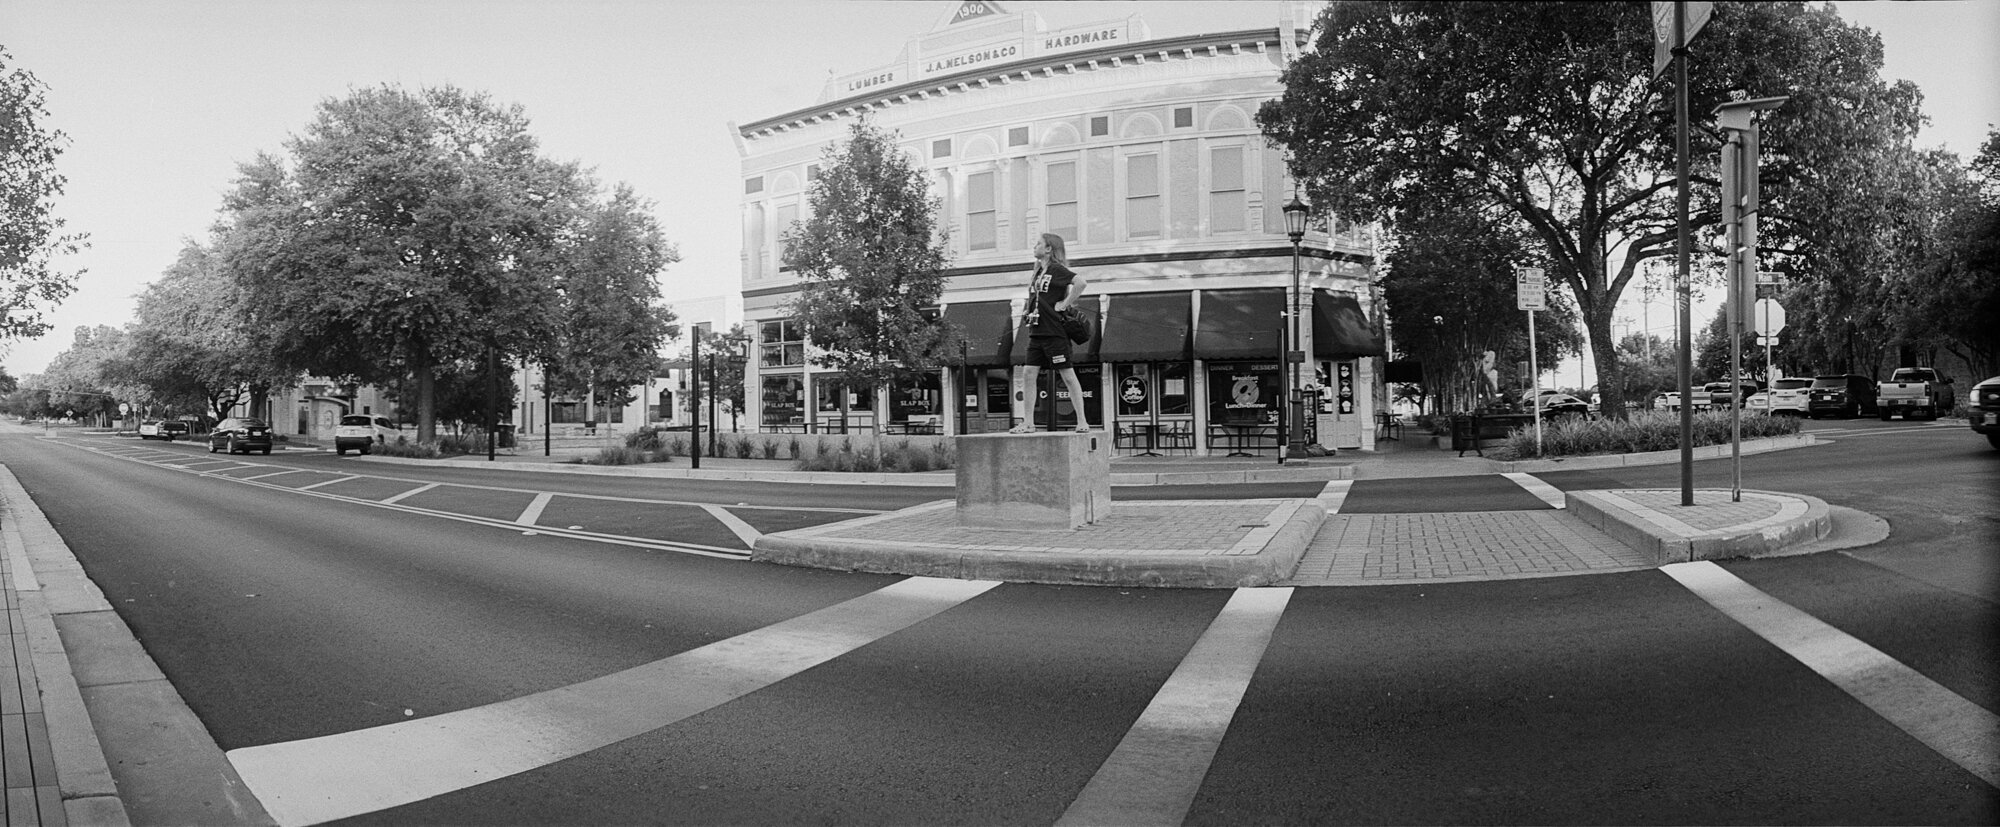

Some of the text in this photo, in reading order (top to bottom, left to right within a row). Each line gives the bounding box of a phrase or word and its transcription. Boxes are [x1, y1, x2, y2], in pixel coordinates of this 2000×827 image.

[959, 4, 984, 18] 1900
[1045, 29, 1118, 50] HARDWARE
[849, 72, 894, 91] LUMBER
[1519, 270, 1526, 282] 2
